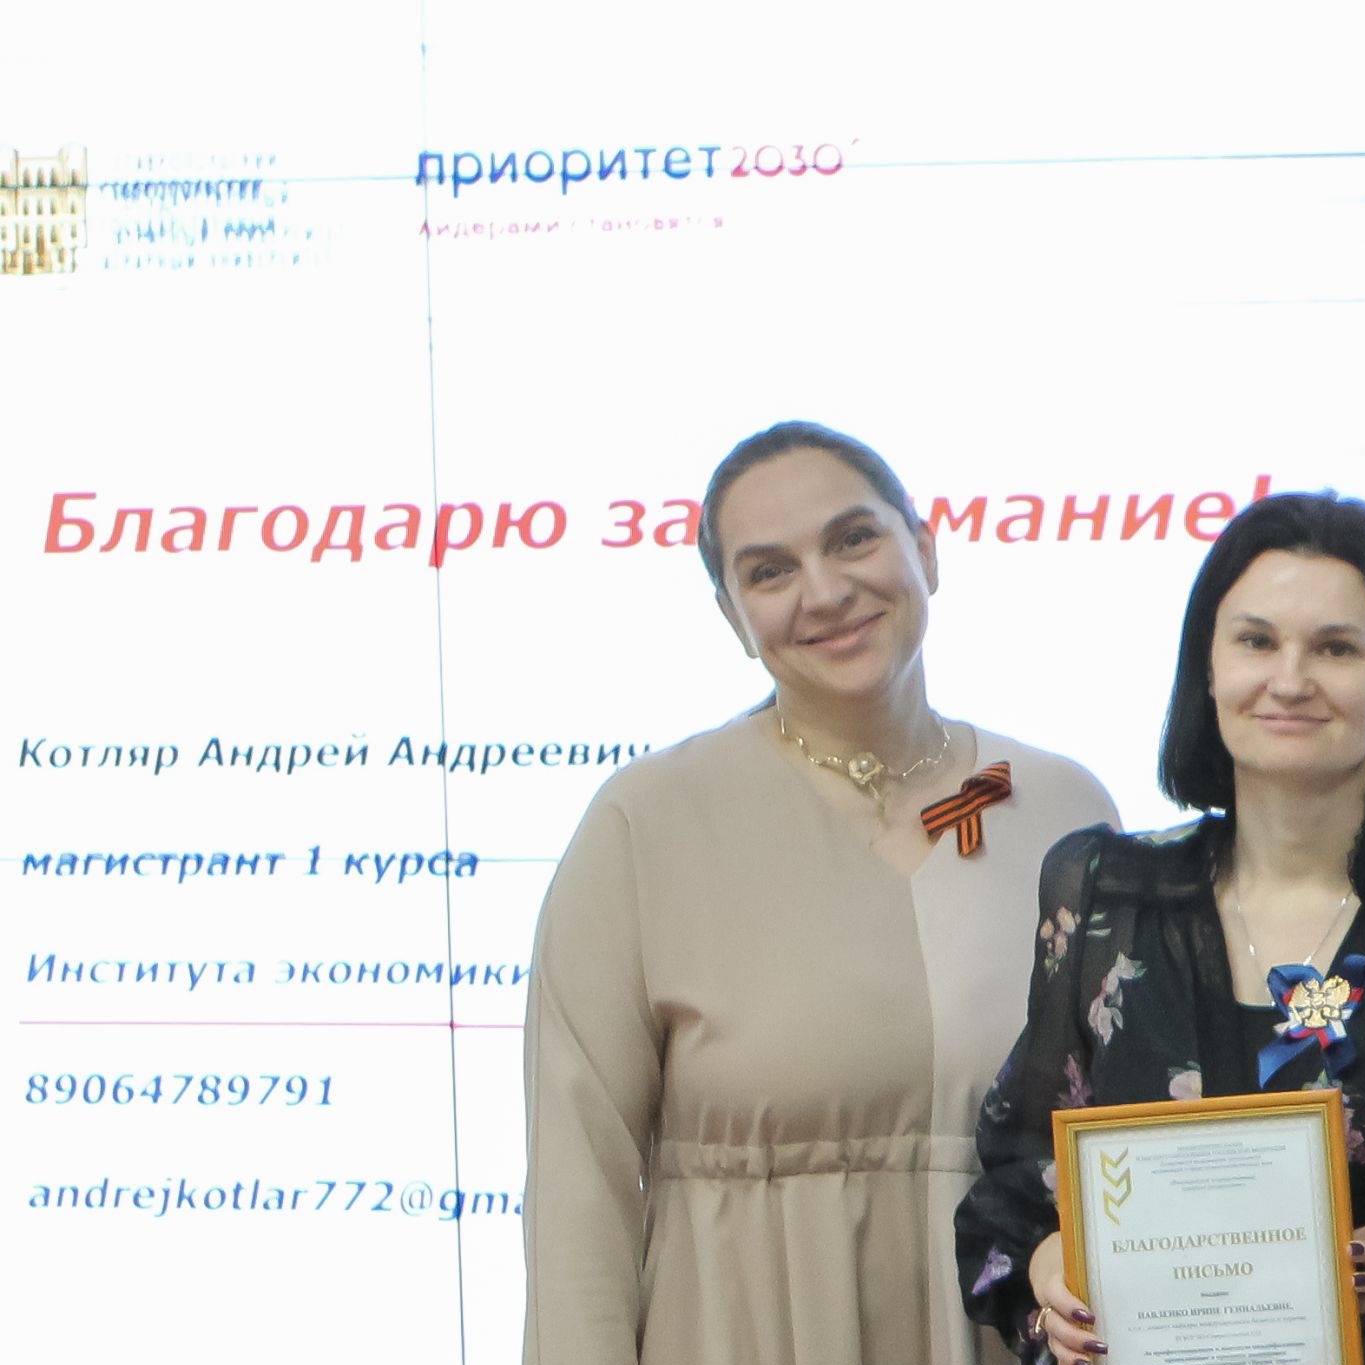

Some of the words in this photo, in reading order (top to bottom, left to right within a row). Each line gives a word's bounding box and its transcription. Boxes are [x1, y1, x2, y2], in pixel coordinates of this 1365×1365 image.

[44, 492, 567, 572] Благодарю
[602, 498, 700, 550] за
[19, 737, 179, 776] Котляр
[198, 734, 369, 776] Андрей
[22, 851, 286, 884] магистрант
[306, 844, 322, 877] 1
[344, 851, 480, 884] курса
[26, 953, 257, 992] Института
[25, 1073, 334, 1106] 89064789791
[1112, 1226, 1307, 1254] БЛАГОДАРСТВЕННОЕ
[1172, 1262, 1254, 1280] ПИСЬМО
